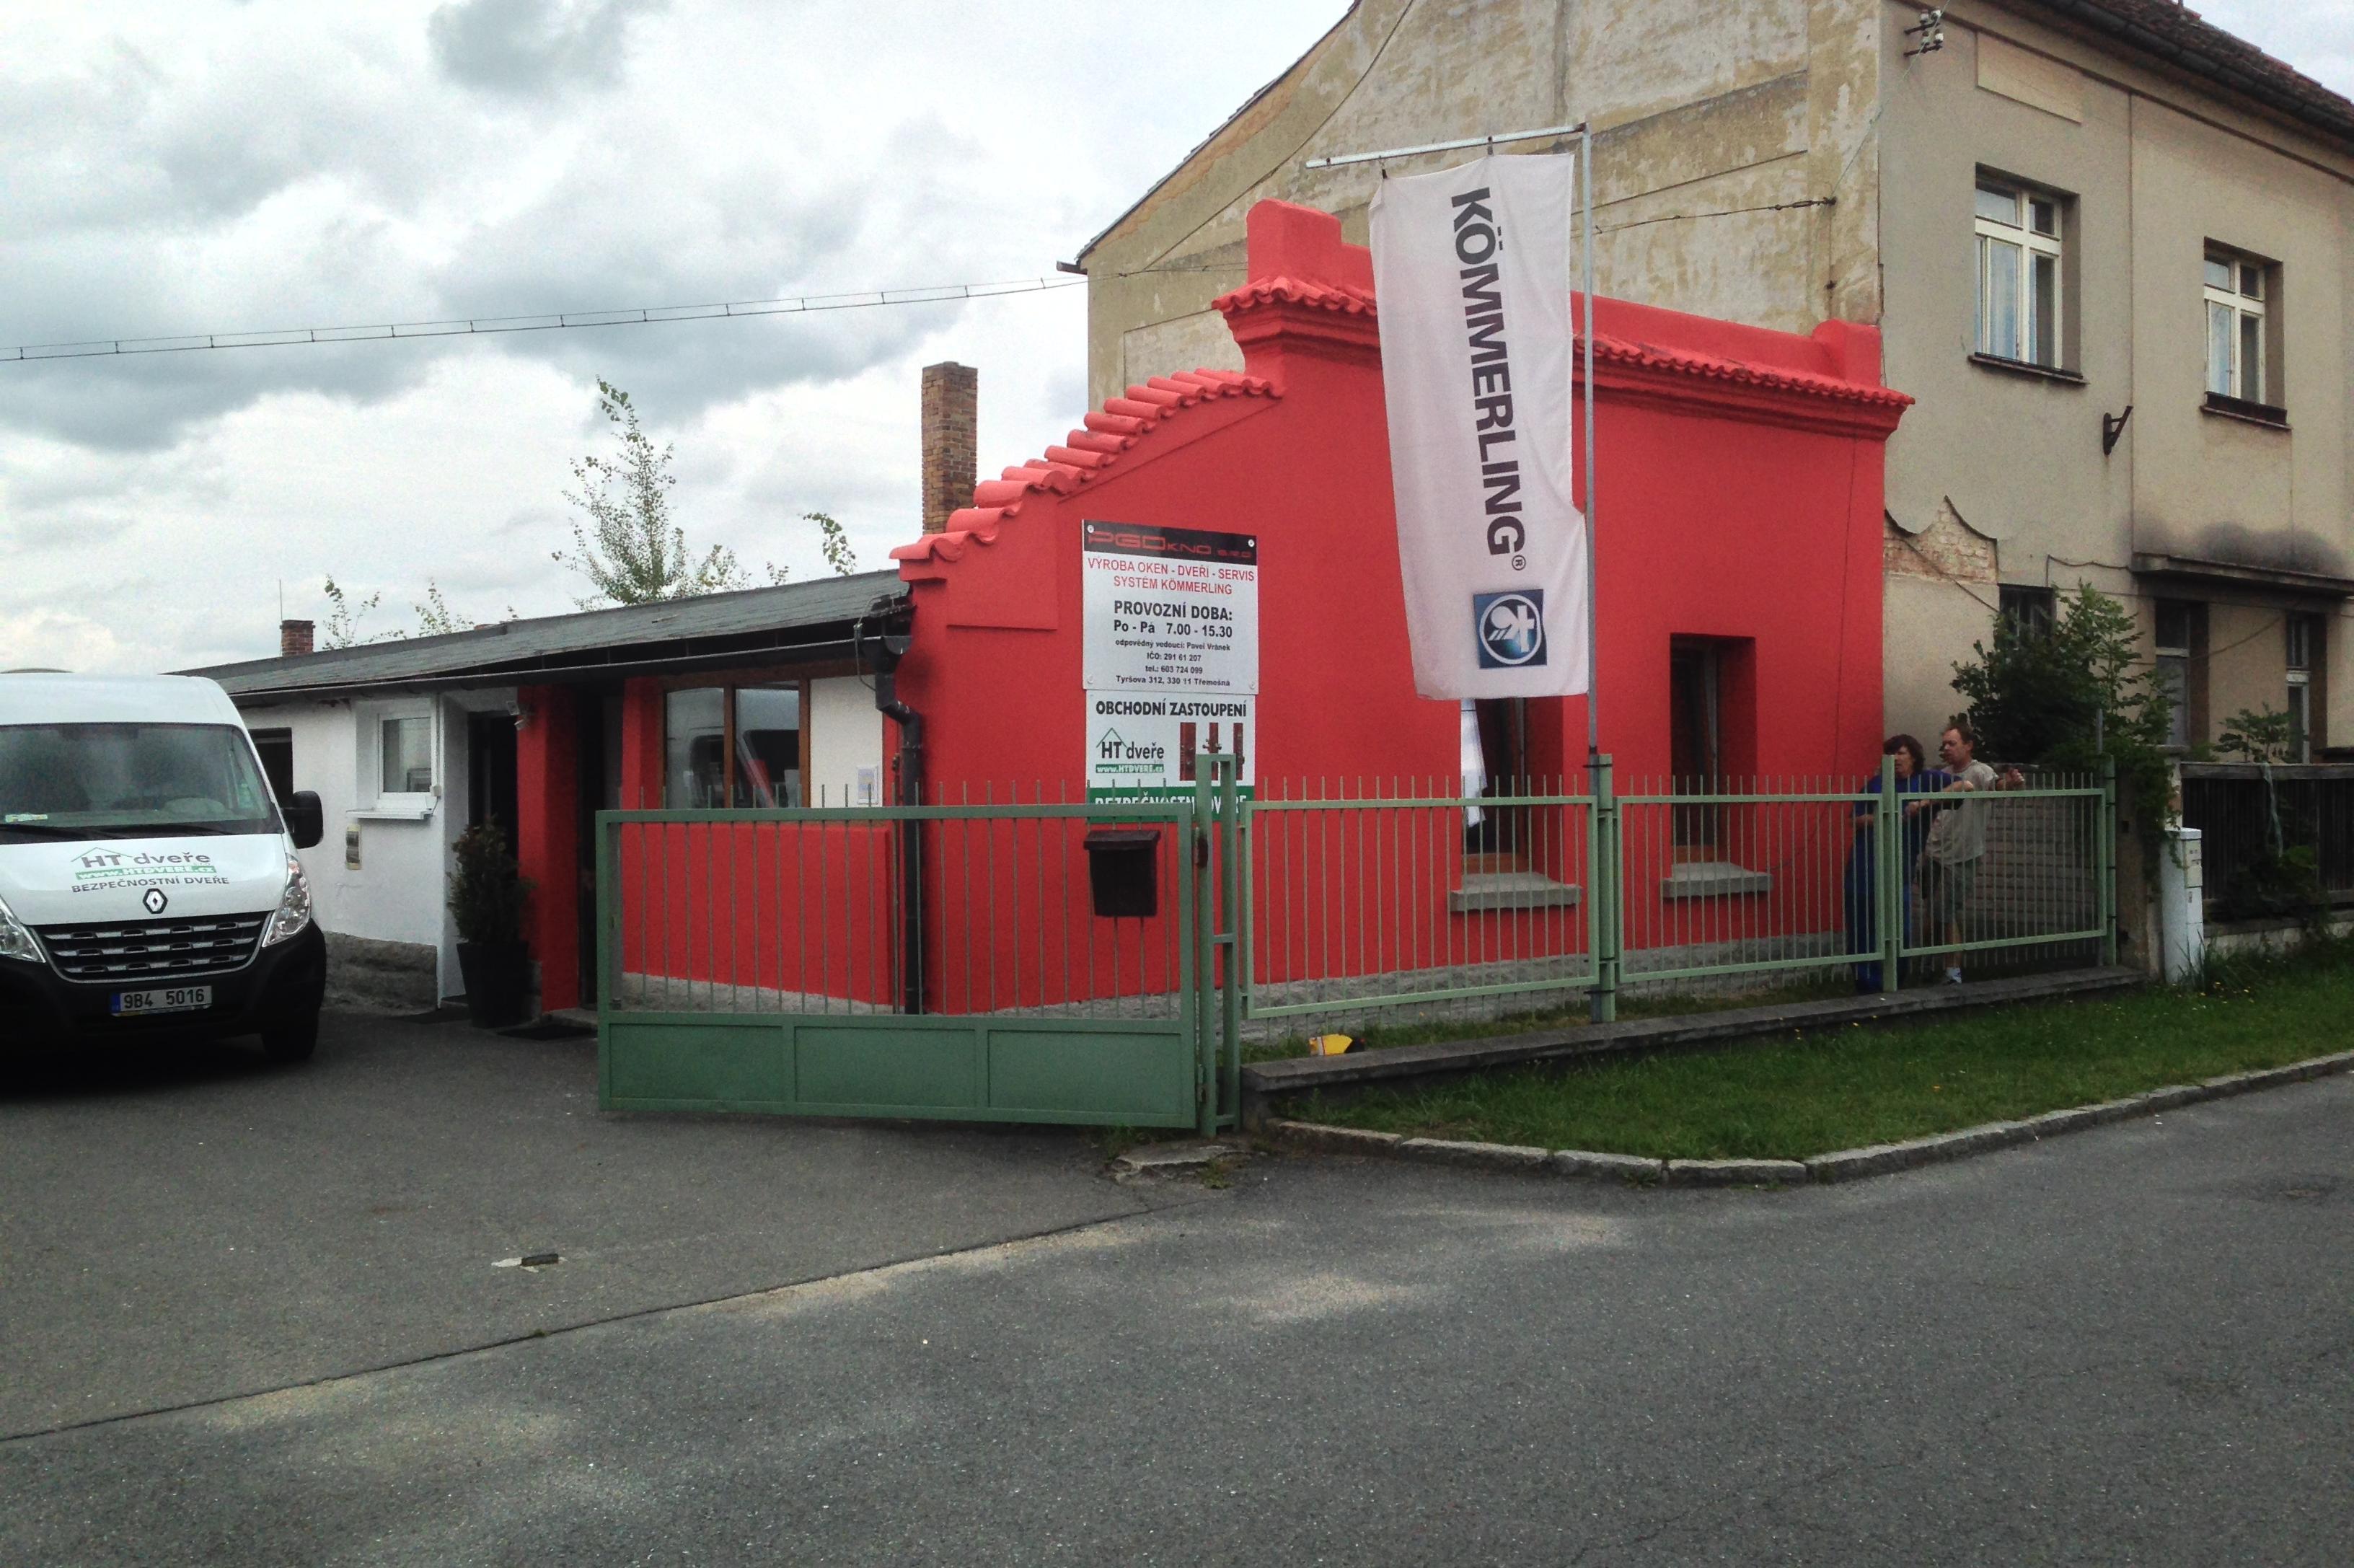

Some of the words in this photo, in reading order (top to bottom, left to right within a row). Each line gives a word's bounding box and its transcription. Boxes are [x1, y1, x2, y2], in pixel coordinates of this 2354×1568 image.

[1088, 556, 1135, 573] VÝROBA
[1138, 561, 1168, 575] OKEN
[1218, 568, 1255, 582] SERVIS
[1161, 578, 1233, 595] KÖMMERLING
[1114, 600, 1186, 618] PROVOZNÍ
[1191, 605, 1233, 621] DOBA:
[1114, 620, 1129, 632] Po
[1140, 621, 1155, 633] Pá
[1166, 622, 1191, 635] 7.00
[1202, 625, 1233, 638] 15.30
[1186, 641, 1205, 650] Pavel
[1116, 675, 1146, 684] Tyršova
[1096, 698, 1166, 715] OBCHODNÍ
[1170, 700, 1247, 717] ZASTOUPENÍ
[1101, 741, 1122, 759] HT
[1126, 741, 1164, 759] dveře
[81, 855, 121, 868] HT
[133, 852, 211, 864] dveře
[71, 876, 180, 893] BEZPEČNOSTNÍ
[185, 876, 229, 885] DVEŘE
[124, 992, 154, 1008] 9B4
[166, 988, 204, 1005] 5016
